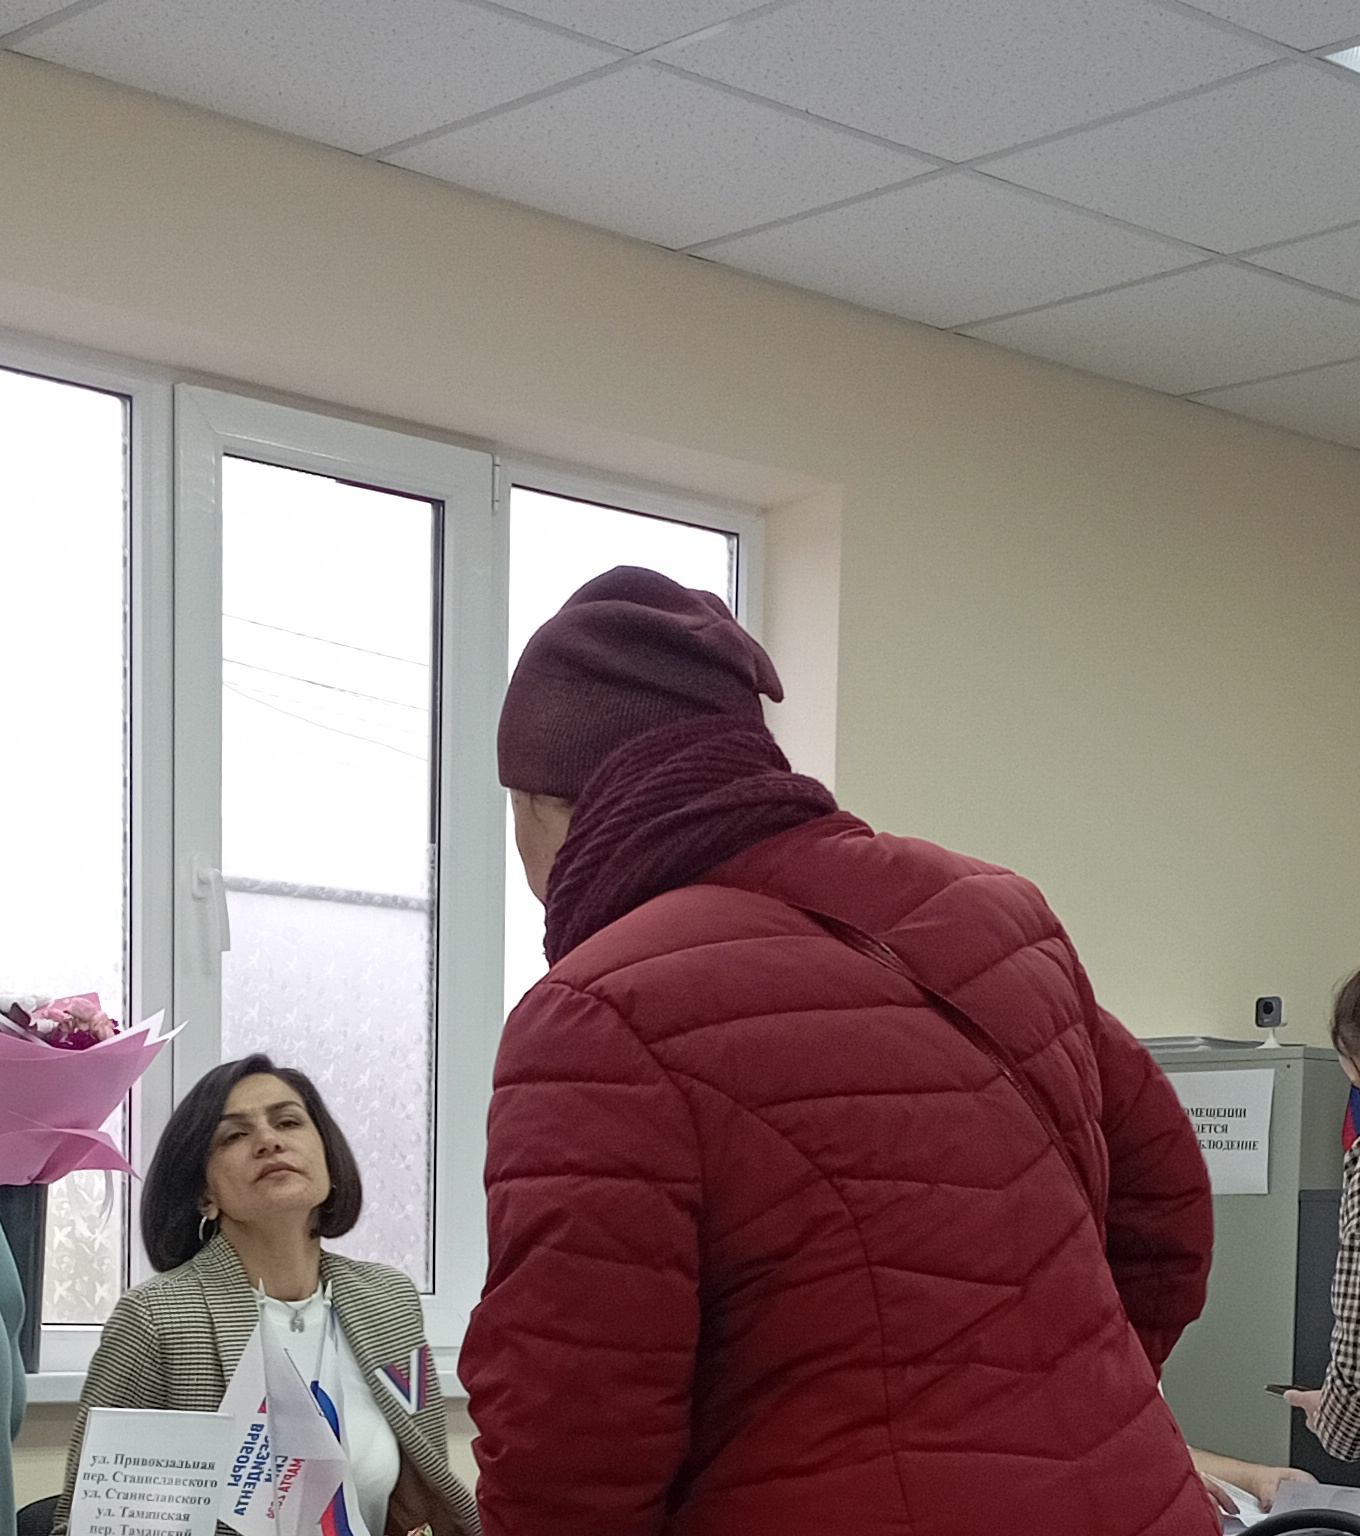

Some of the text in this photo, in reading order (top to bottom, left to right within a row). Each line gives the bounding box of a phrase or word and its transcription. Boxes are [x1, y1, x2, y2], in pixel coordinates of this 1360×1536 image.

[1184, 1107, 1247, 1119] МЕЩЕНИИ
[1195, 1123, 1229, 1135] ДЕТСЯ
[1198, 1139, 1259, 1151] БЛЮДЕНИЕ
[90, 1453, 216, 1470] ул. Привокзальная
[82, 1470, 218, 1488] пер. Станиславского
[81, 1487, 211, 1505] ул. Станиславского
[95, 1506, 191, 1522] ул. Таманская
